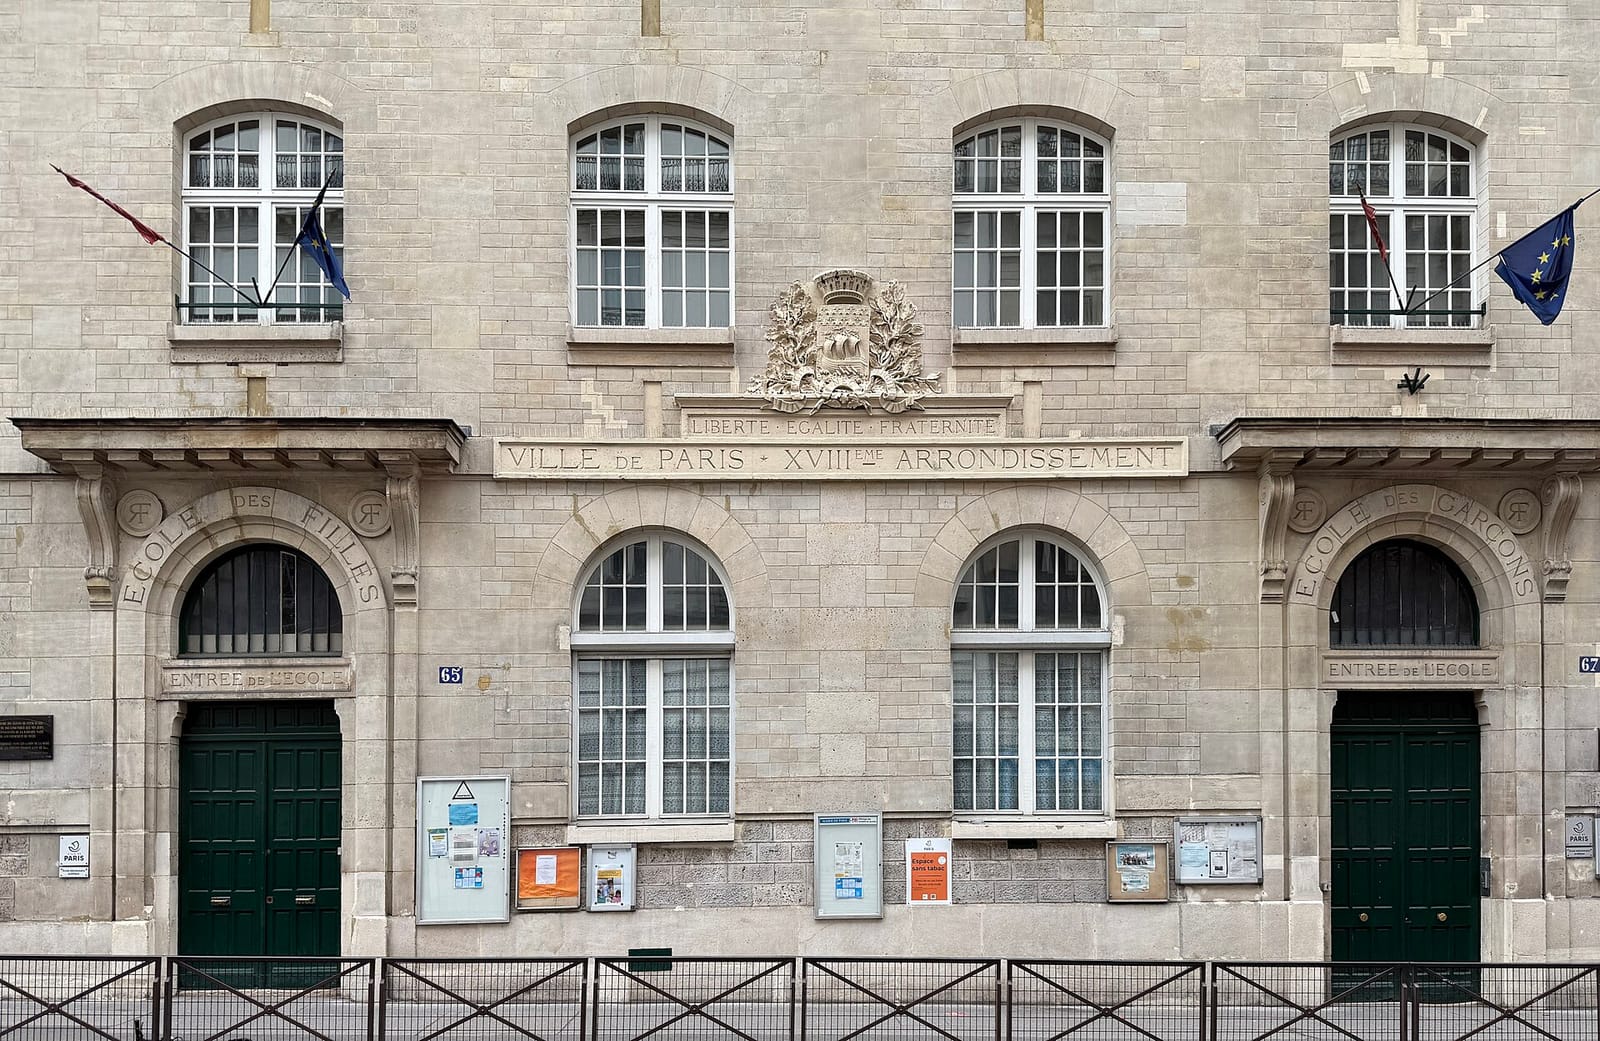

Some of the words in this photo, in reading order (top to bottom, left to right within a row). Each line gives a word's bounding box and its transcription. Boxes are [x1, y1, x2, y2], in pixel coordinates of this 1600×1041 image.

[692, 419, 770, 435] LIBERTE
[786, 419, 864, 434] EGALITE
[879, 417, 996, 434] FRATERNITE
[507, 448, 600, 470] VILLE
[616, 455, 644, 470] DE
[658, 449, 745, 470] PARIS
[895, 447, 1175, 470] ARRONDISSEMENT
[123, 506, 203, 605] ECOLE
[234, 494, 272, 508] DES
[301, 506, 379, 603] FILLES
[1296, 501, 1371, 597] ECOLE
[1384, 492, 1419, 507] DES
[1329, 663, 1399, 677] ENTREE
[1424, 663, 1491, 677] L'ECOLE
[1581, 657, 1599, 671] 67
[170, 672, 243, 687] ENTREE
[270, 671, 344, 686] L'ECOLE
[441, 667, 461, 682] 65
